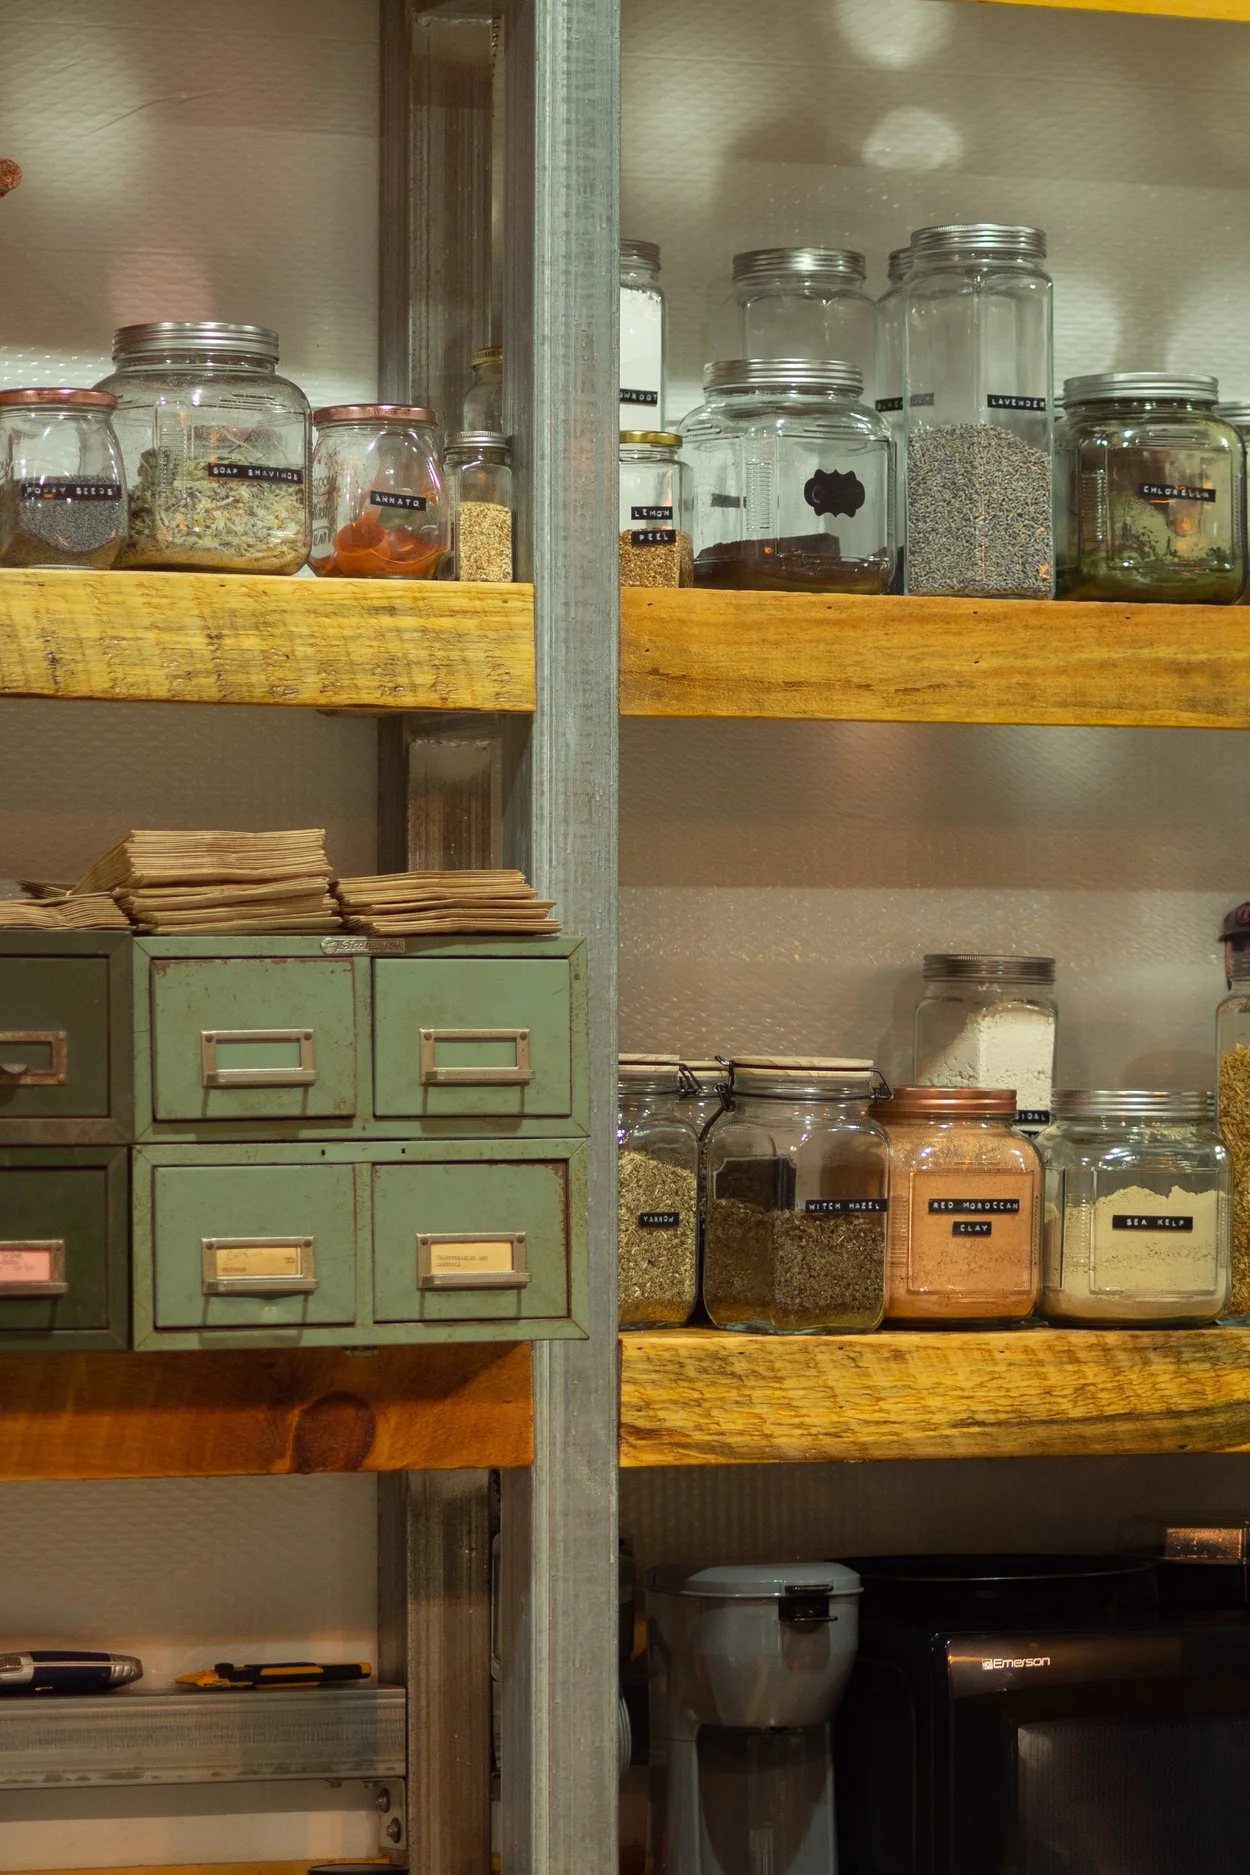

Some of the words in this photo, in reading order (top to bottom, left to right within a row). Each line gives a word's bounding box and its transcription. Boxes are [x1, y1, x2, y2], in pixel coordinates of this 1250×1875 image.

[991, 398, 1046, 408] LAVENDER
[213, 466, 238, 475] SOAP
[248, 468, 298, 481] SHAVINGS
[76, 486, 113, 496] SEEDS
[1143, 485, 1210, 498] CHLORELLA
[375, 493, 422, 508] ANNATO
[634, 508, 670, 517] LEMON
[639, 533, 669, 541] PEEL
[809, 1202, 841, 1210] WITCH
[849, 1202, 880, 1210] HAZEL
[933, 1201, 954, 1209] RED
[963, 1201, 1018, 1210] MOROCCAN
[643, 1215, 674, 1224] YARROW
[1126, 1218, 1148, 1226] SEA
[1157, 1218, 1185, 1227] KELP
[960, 1224, 988, 1232] CLAY
[993, 1657, 1051, 1668] Emerson
